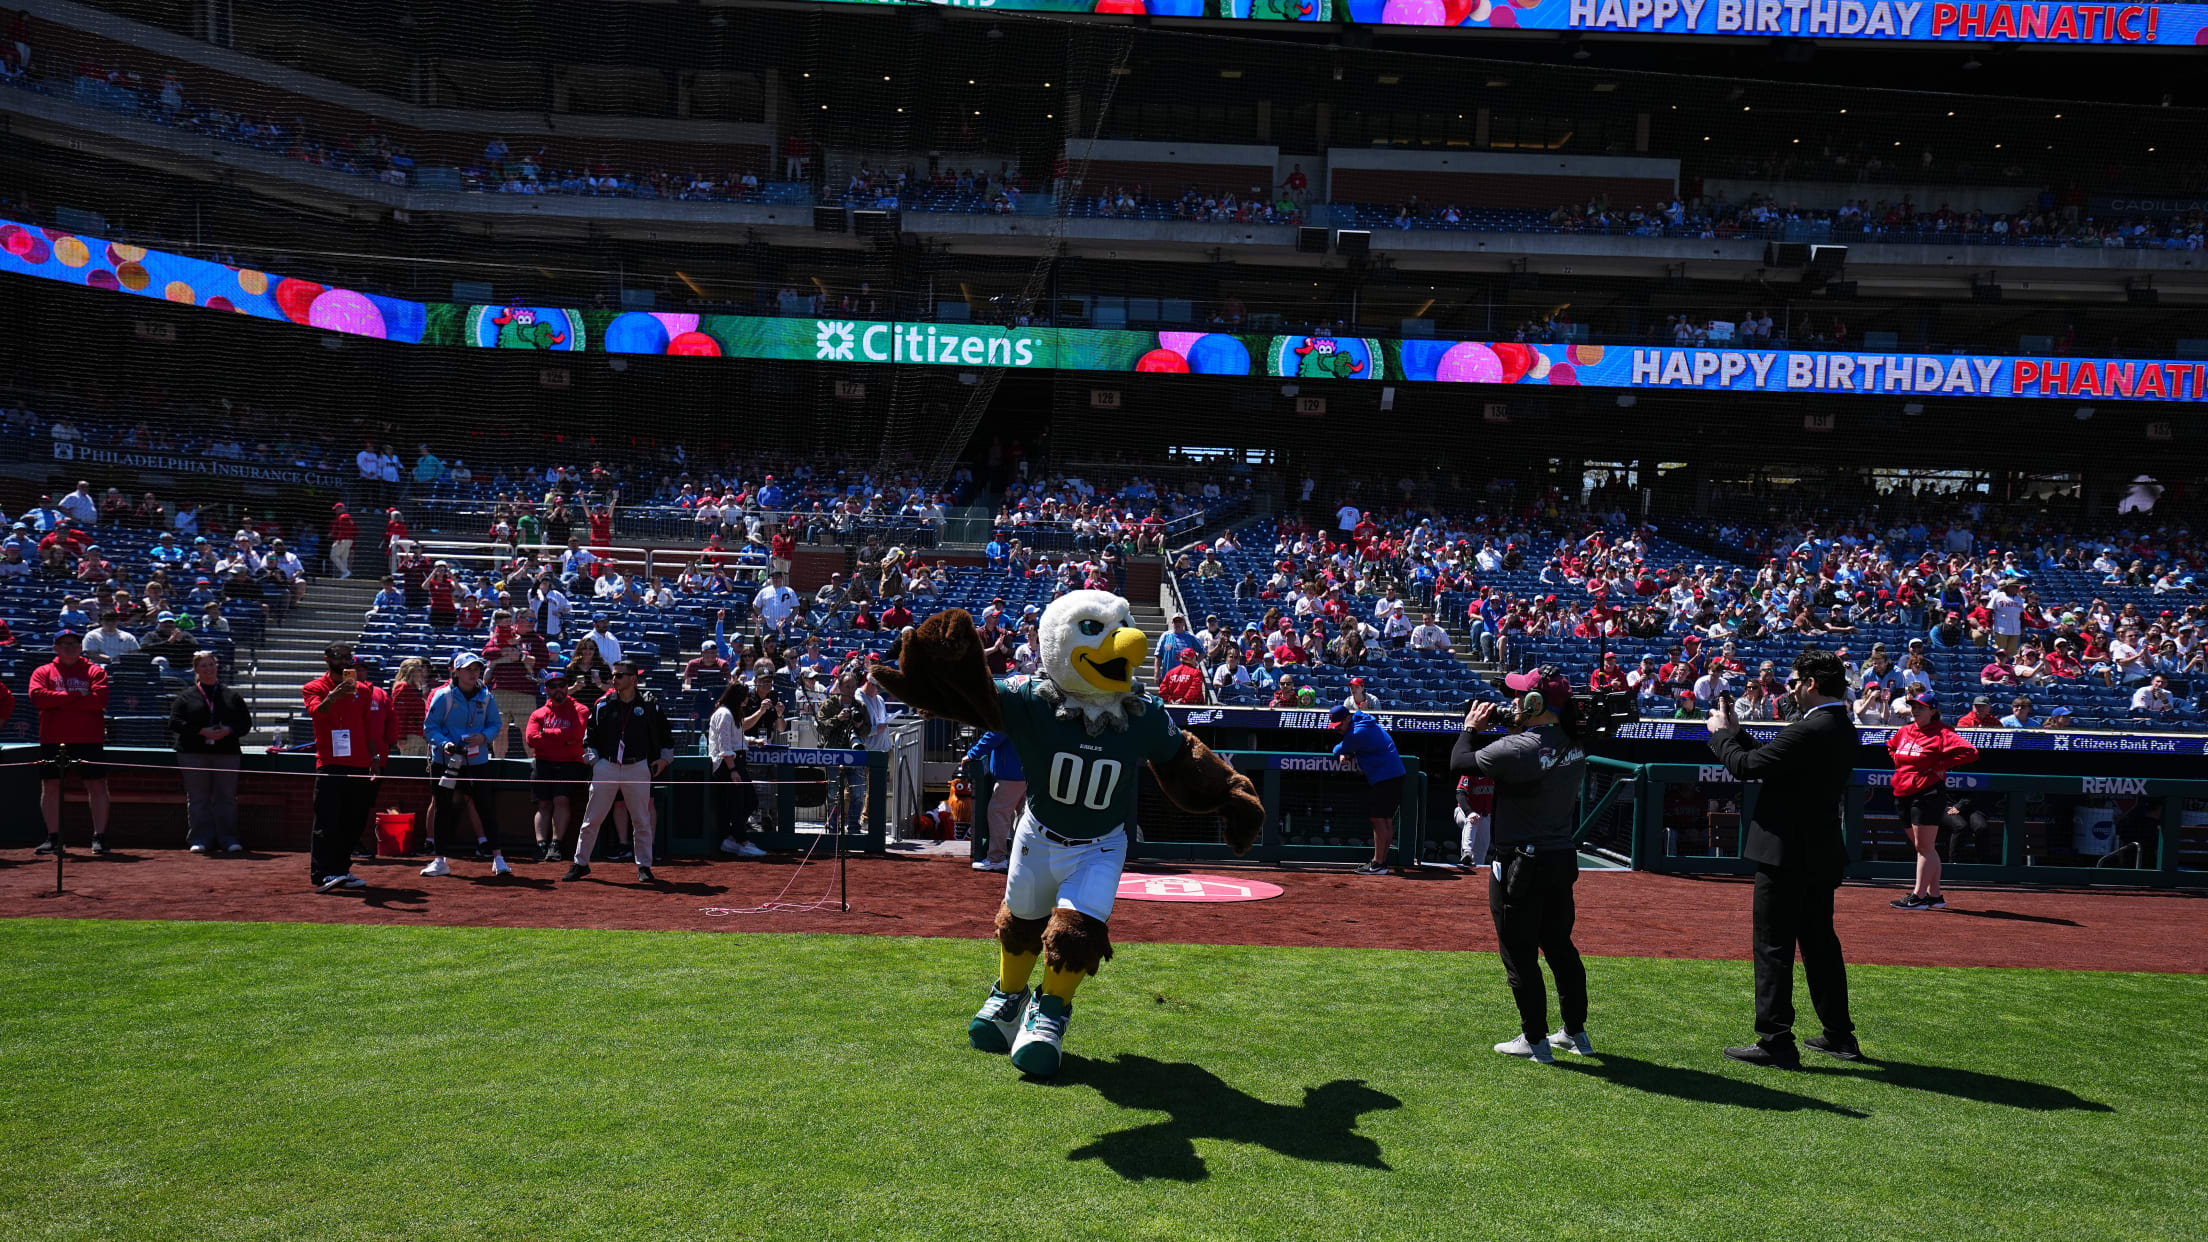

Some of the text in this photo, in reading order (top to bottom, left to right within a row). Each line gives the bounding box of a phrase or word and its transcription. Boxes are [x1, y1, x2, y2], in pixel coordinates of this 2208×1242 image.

[1569, 0, 2161, 41] HAPPY BIRTHDAY PHANATIC!
[862, 324, 1033, 367] Citizens
[1632, 350, 2208, 399] HAPPY BIRTHDAY PHANATI
[1097, 391, 1114, 404] 128
[1303, 399, 1320, 411] 129
[1170, 674, 1191, 684] STAFF
[1279, 712, 1331, 729] PHILLIES.CO
[1396, 718, 1465, 731] Citizens Ban
[1616, 722, 1675, 740] PHILLIES.COM
[1080, 743, 1104, 752] EAGLES
[2072, 737, 2176, 752] Citizens Bank Park
[745, 750, 840, 766] smartwater
[1280, 755, 1360, 772] smartwat
[1049, 751, 1122, 811] 00
[1698, 766, 1765, 784] REM
[2081, 776, 2148, 795] REMAX
